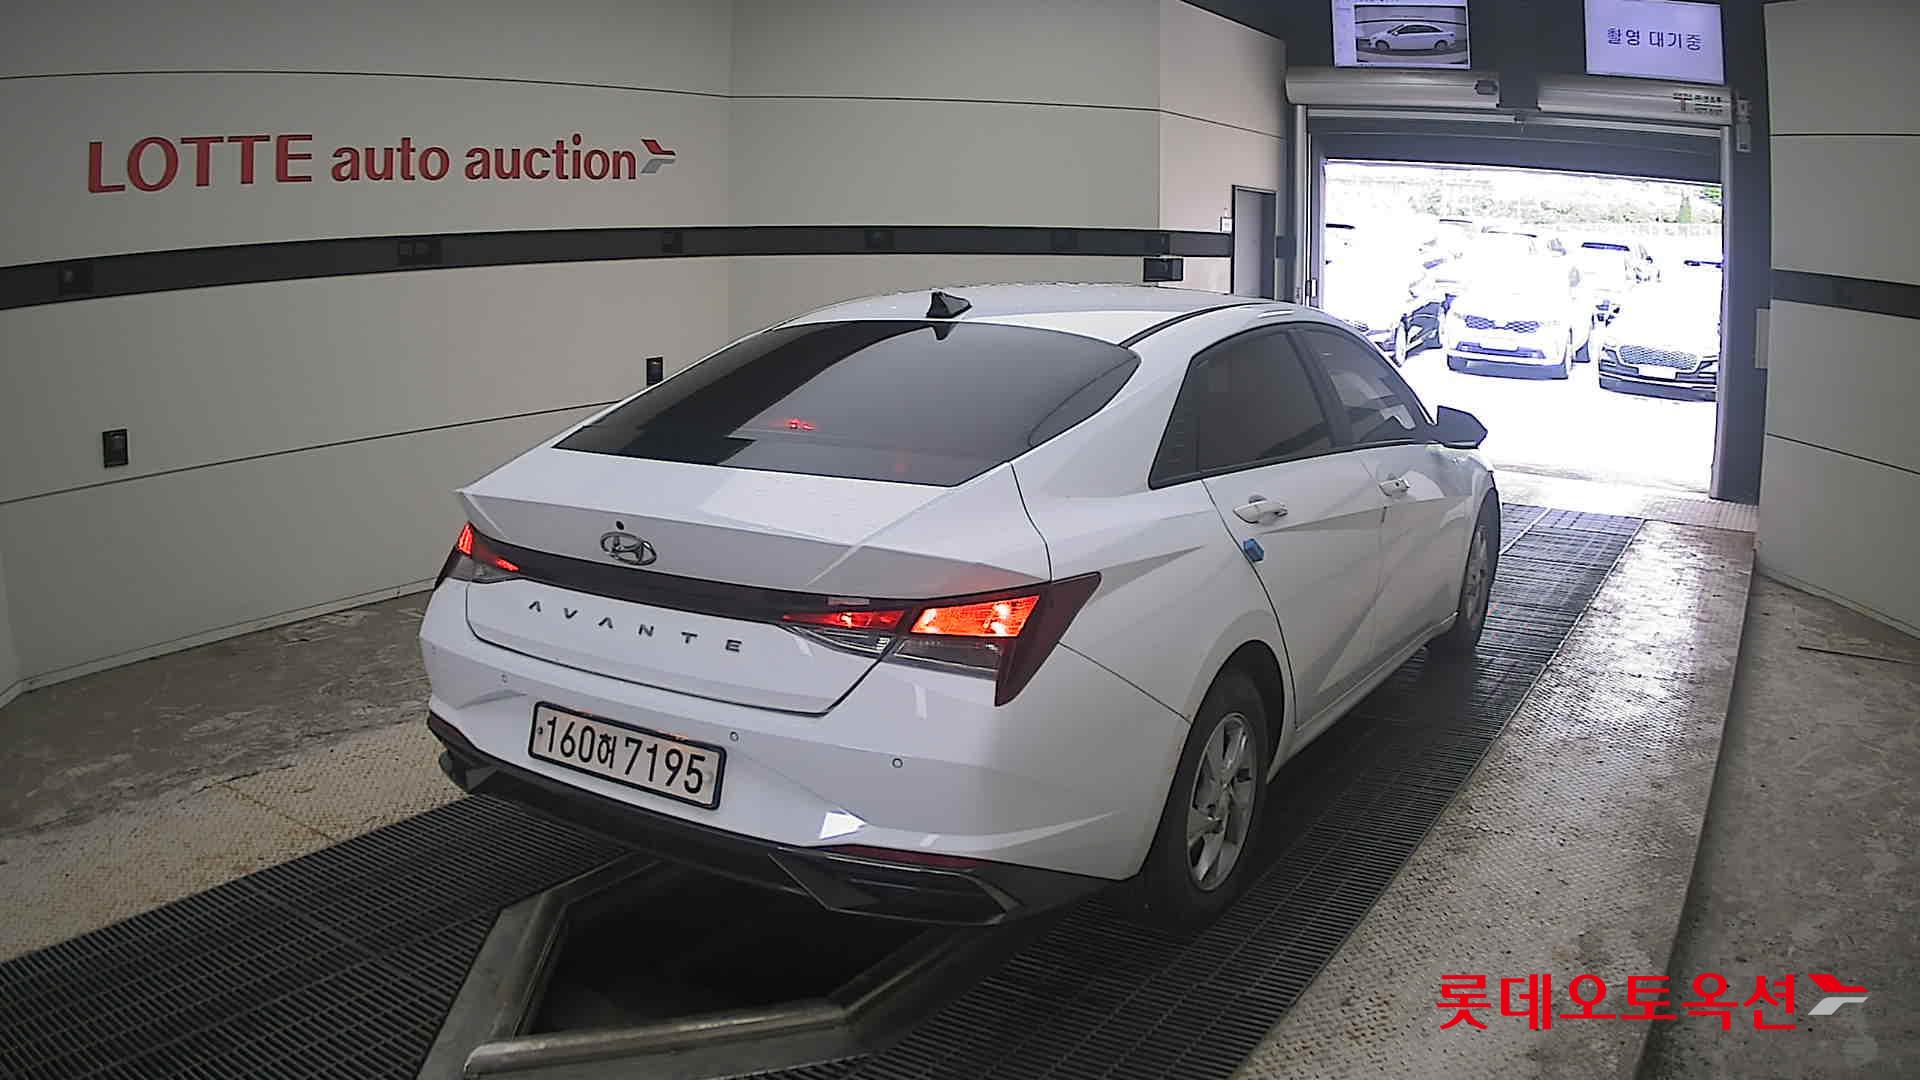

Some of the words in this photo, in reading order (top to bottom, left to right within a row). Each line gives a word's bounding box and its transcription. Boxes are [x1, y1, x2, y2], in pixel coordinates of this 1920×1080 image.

[1649, 31, 1702, 52] 대기중
[88, 134, 313, 193] LOTTE
[331, 137, 451, 183] auto
[464, 133, 638, 181] auction
[528, 600, 743, 653] AVANTE
